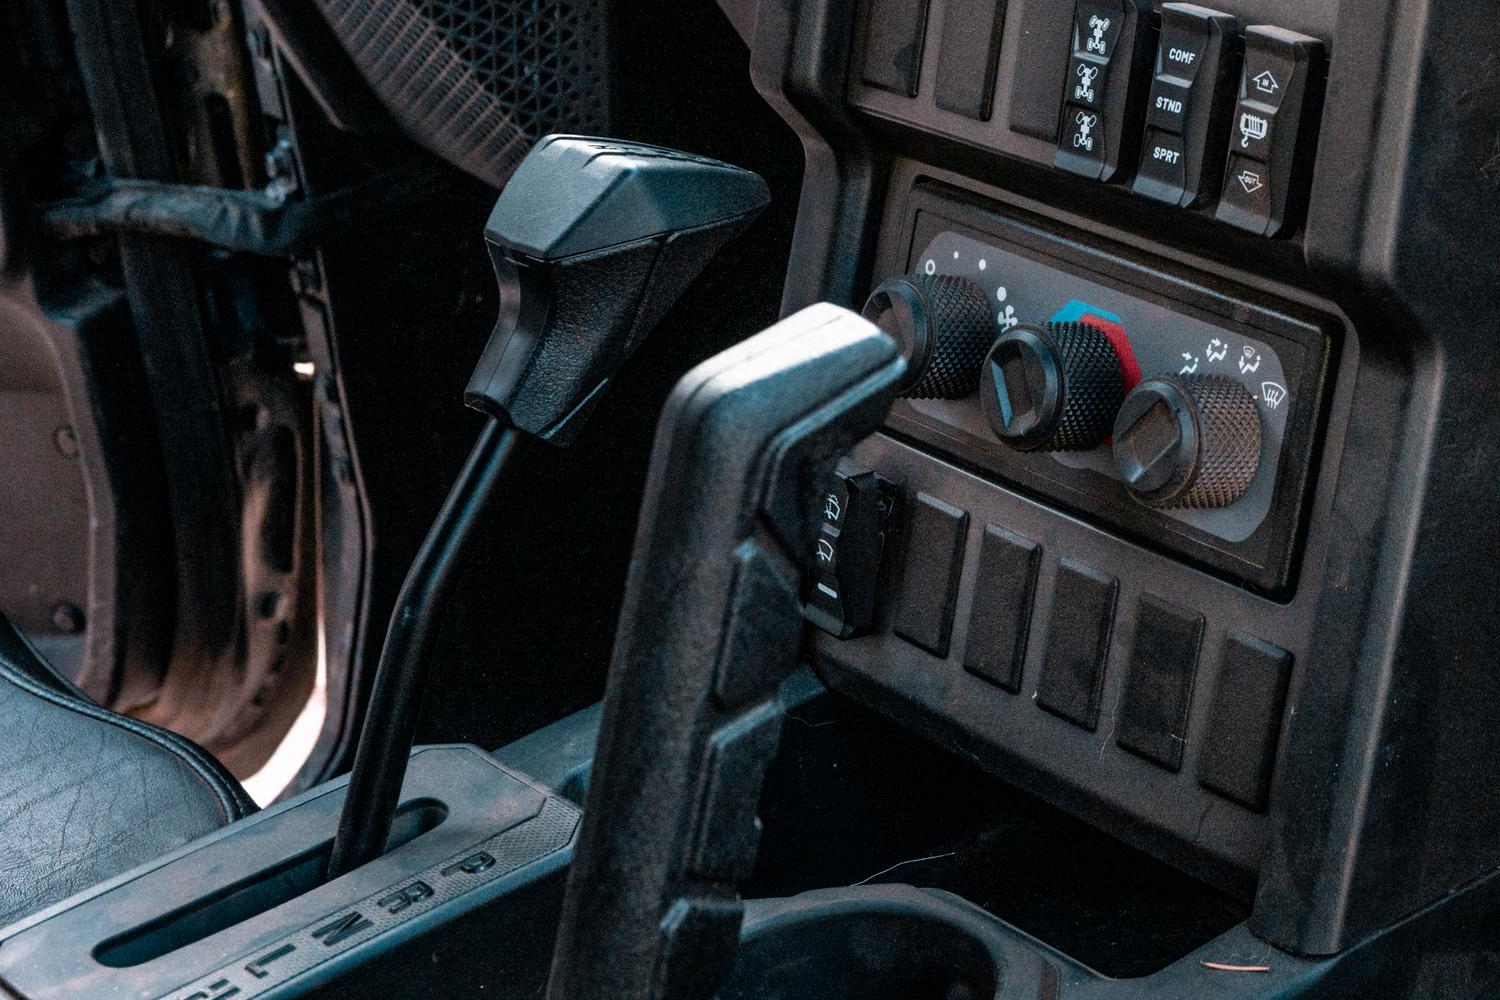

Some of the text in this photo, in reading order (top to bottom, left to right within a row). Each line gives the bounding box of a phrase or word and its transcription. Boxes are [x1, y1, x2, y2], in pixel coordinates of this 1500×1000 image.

[1169, 48, 1195, 64] COMF
[1156, 97, 1182, 114] STND
[1153, 147, 1179, 164] SPRT
[1244, 174, 1256, 184] OUT
